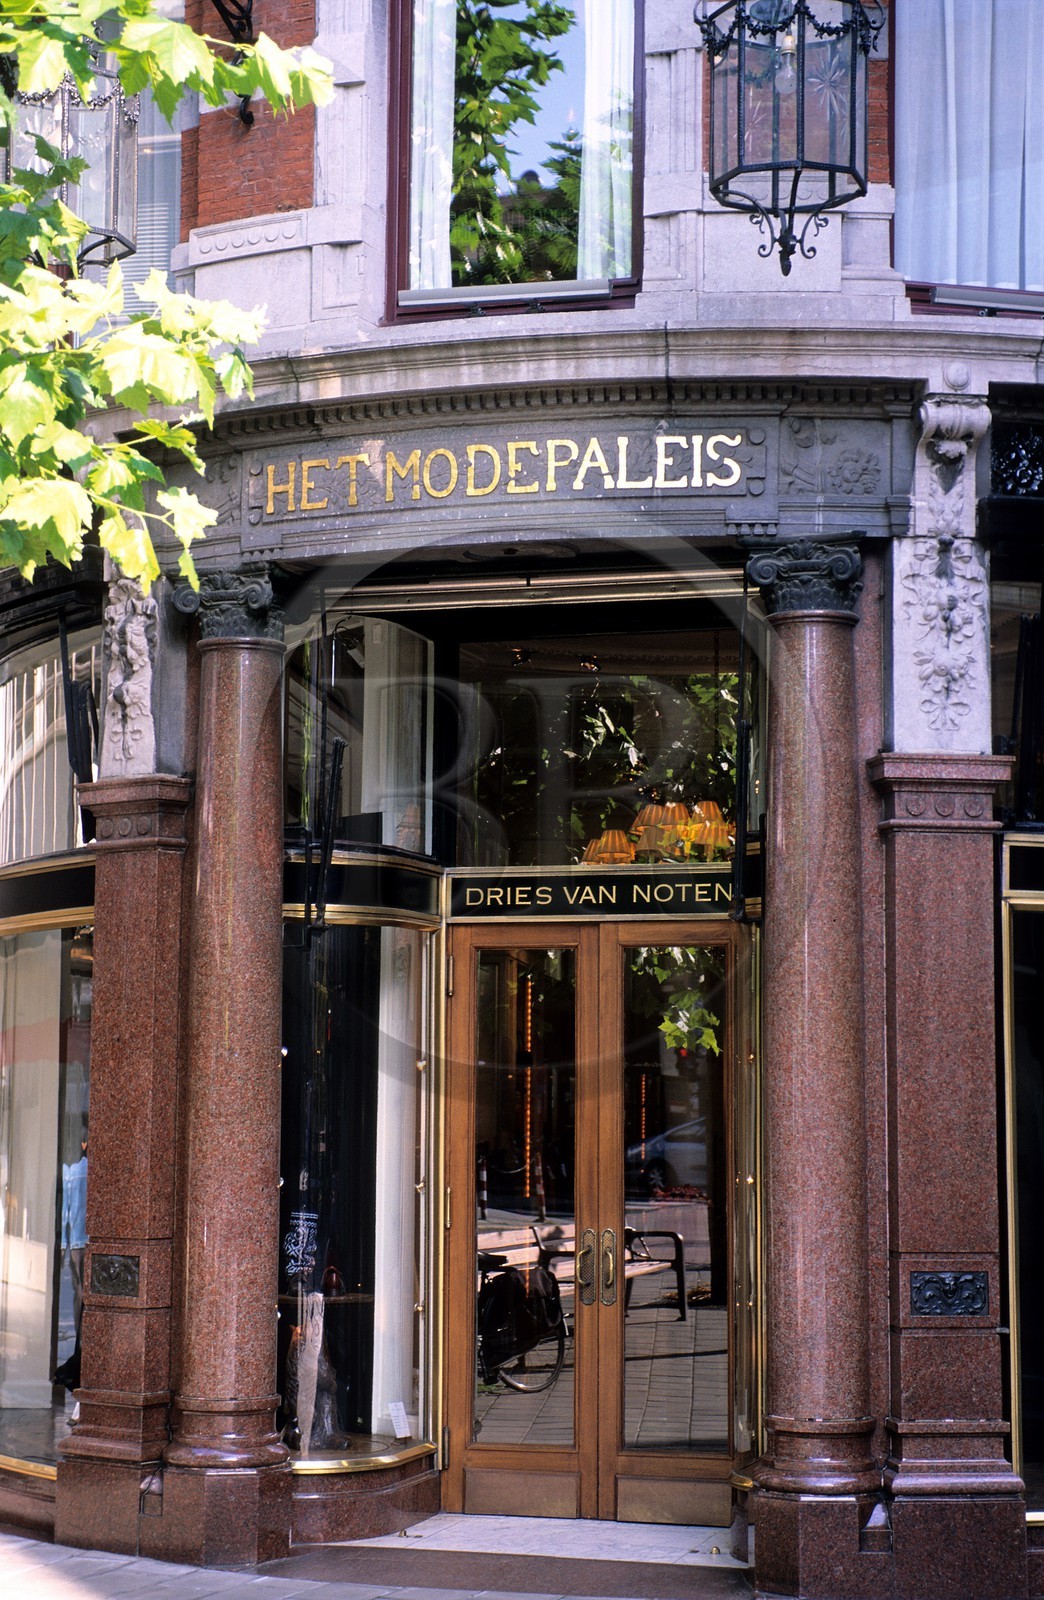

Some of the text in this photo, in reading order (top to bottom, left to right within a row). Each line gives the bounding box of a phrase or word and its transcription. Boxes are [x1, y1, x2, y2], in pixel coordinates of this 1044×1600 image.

[266, 452, 371, 514] HET
[465, 882, 733, 906] DRIES VAN NOTEN
